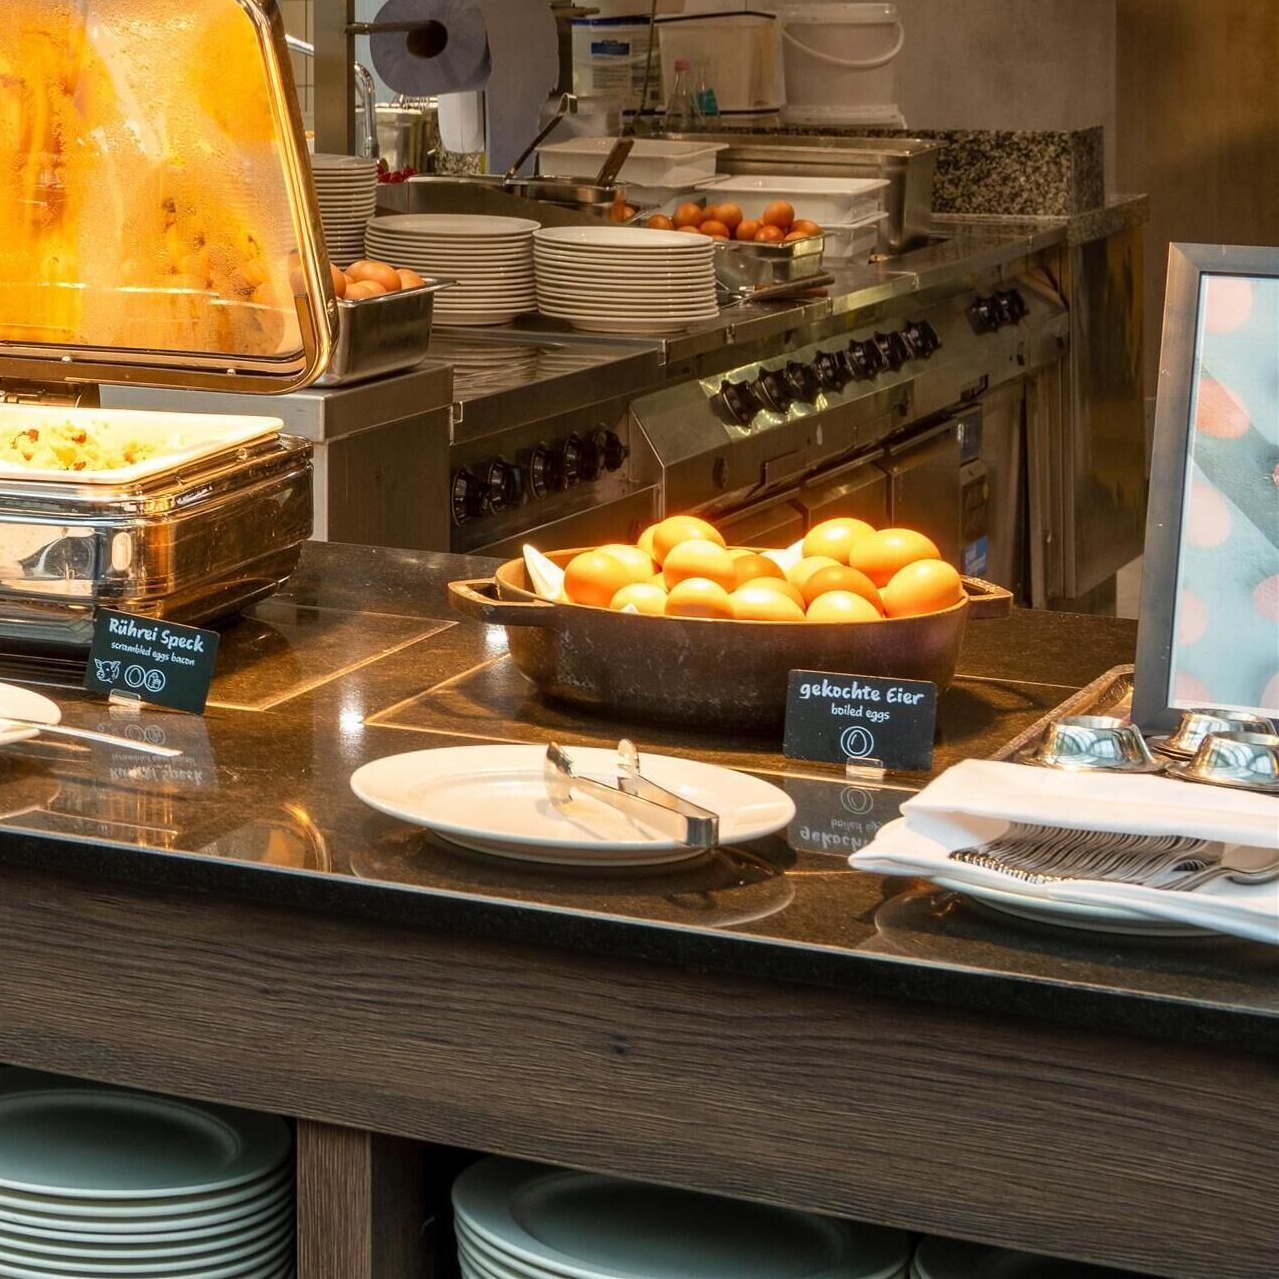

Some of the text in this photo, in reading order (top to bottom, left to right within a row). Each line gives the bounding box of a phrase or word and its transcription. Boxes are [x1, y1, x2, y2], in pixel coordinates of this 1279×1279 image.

[109, 617, 204, 653] Rührei Speck
[110, 641, 195, 666] scrambled eggs bacon
[798, 679, 925, 705] gekochte Eier
[830, 702, 891, 723] boiled eggs
